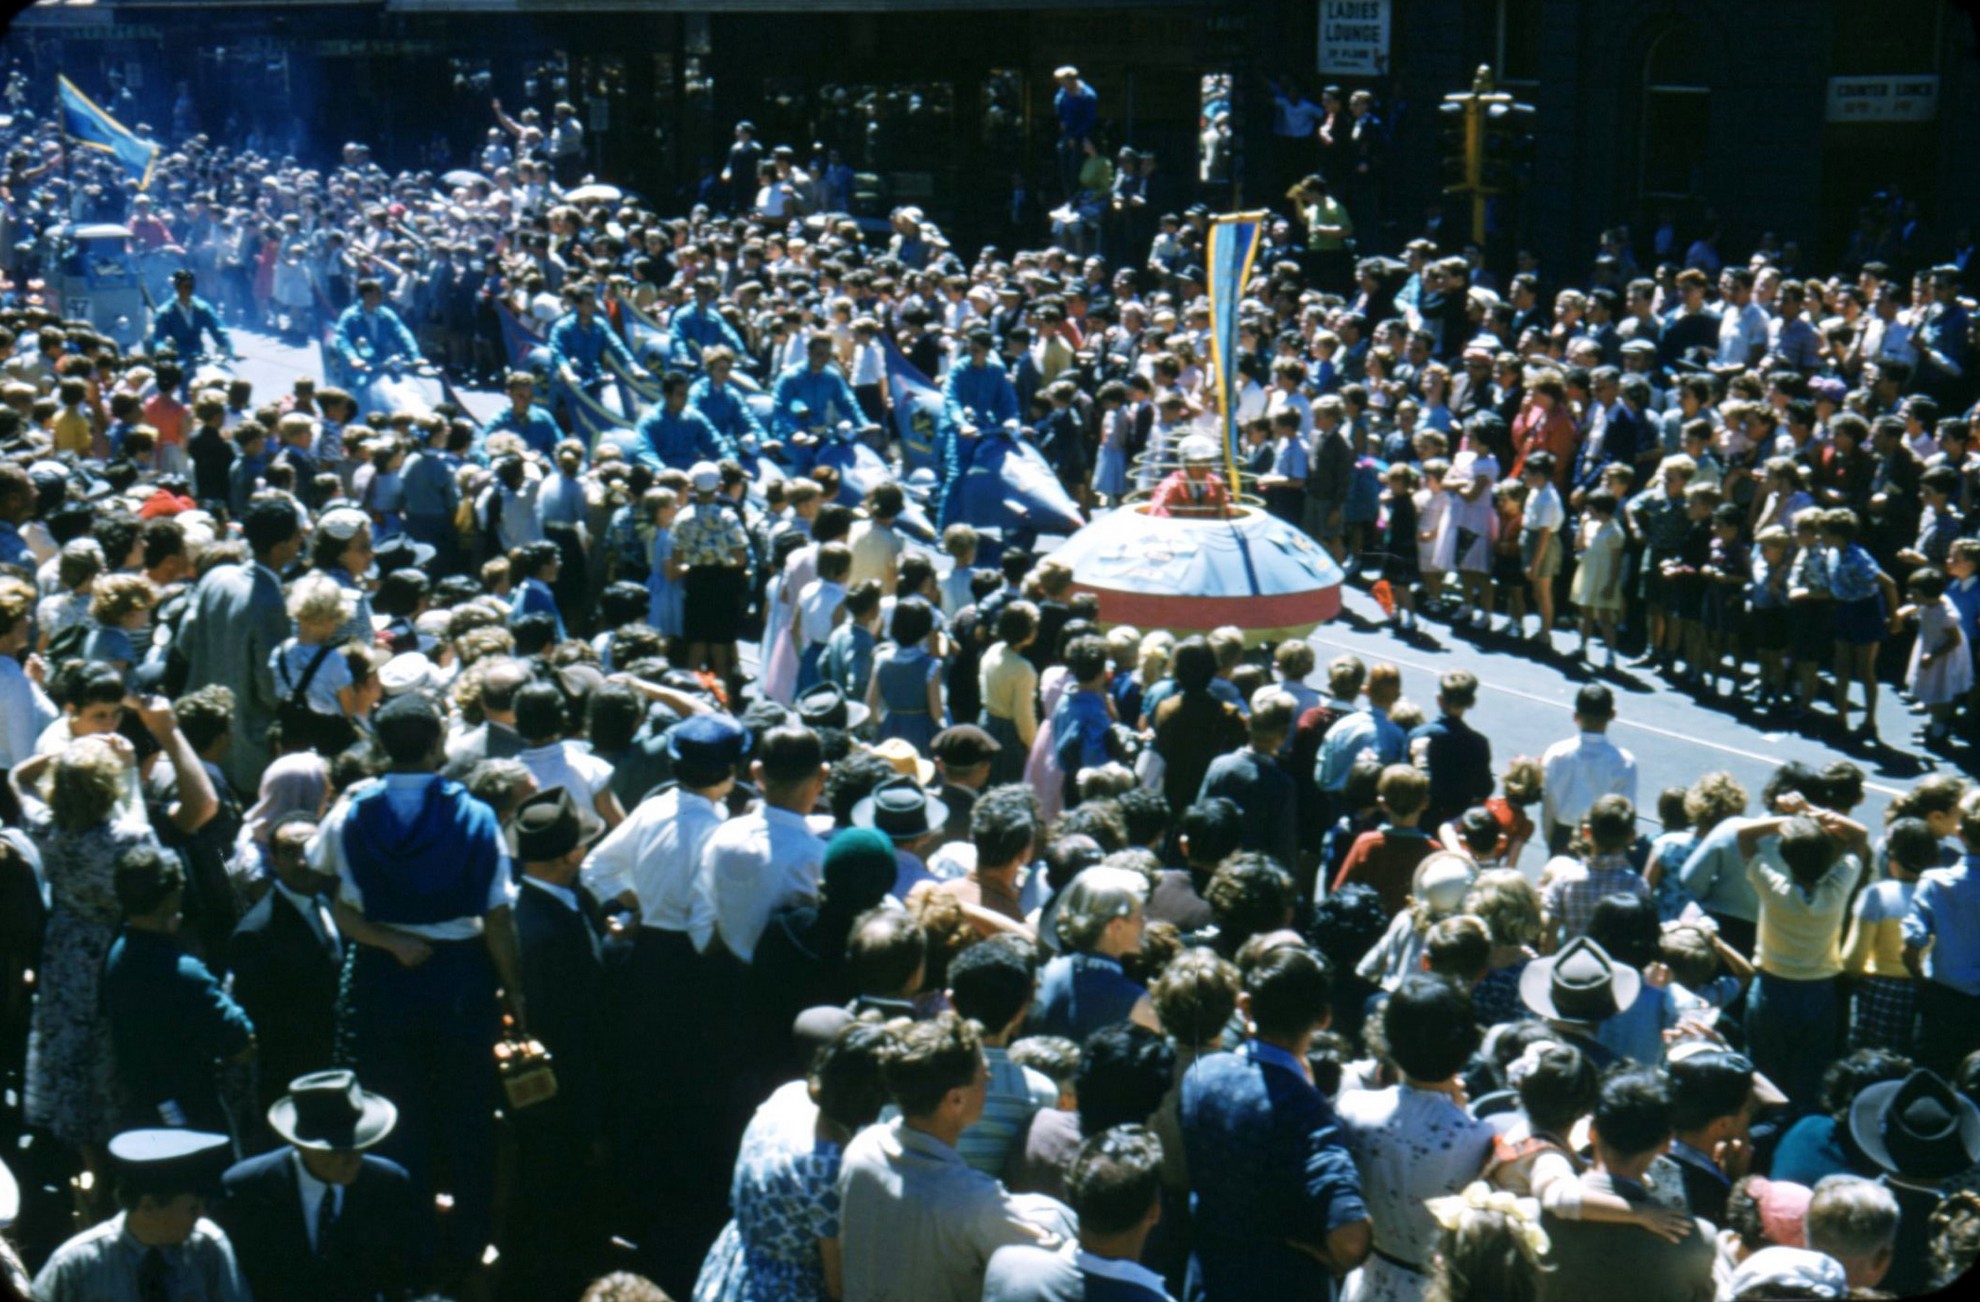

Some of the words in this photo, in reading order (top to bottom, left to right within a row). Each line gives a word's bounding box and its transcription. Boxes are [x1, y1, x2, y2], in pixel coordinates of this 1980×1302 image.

[1327, 1, 1379, 19] LADIES
[1325, 25, 1381, 42] LOUNGE
[1838, 83, 1889, 97] COUNTER
[1896, 83, 1934, 96] LUNCH
